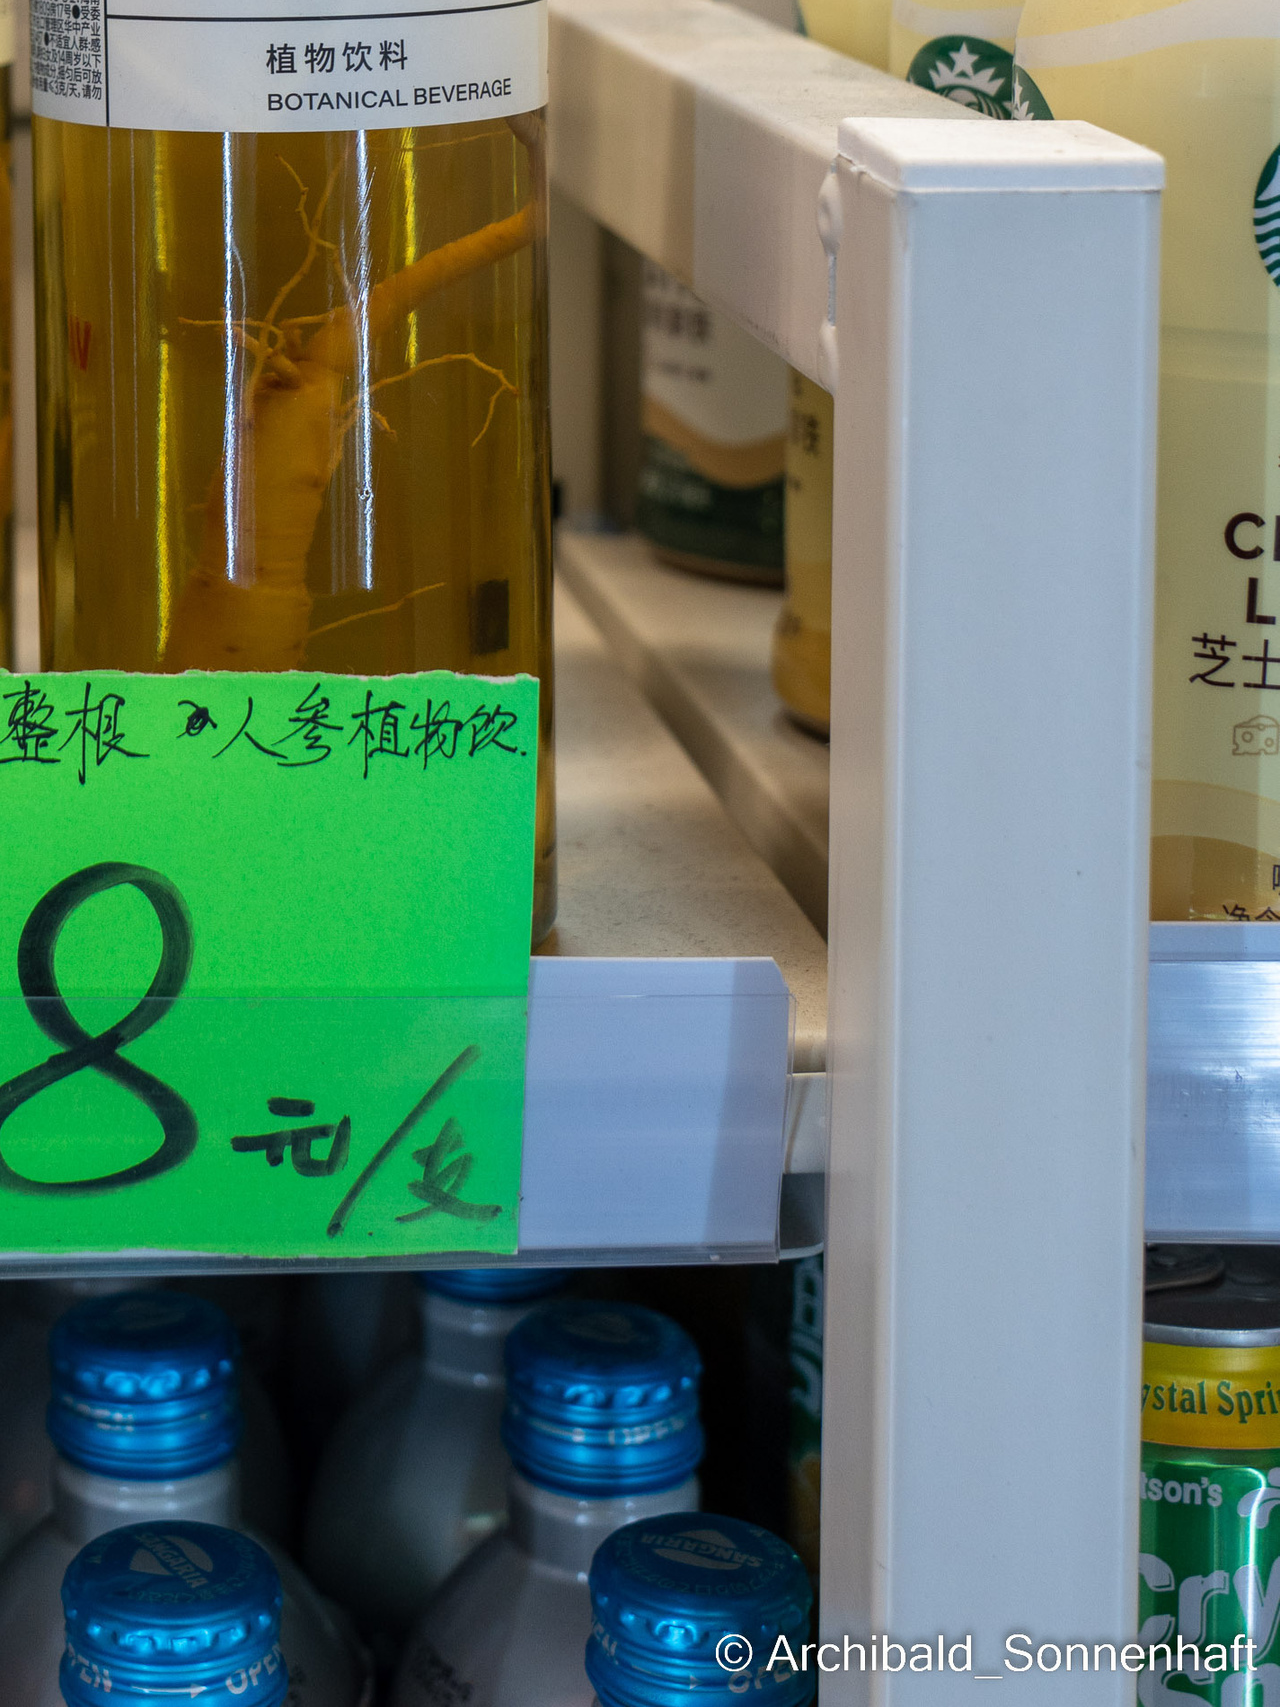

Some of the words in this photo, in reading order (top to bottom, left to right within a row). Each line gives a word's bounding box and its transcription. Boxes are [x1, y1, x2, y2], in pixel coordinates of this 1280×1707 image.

[266, 39, 410, 76] 植物饮料
[266, 90, 409, 113] BOTANICAL
[412, 77, 513, 106] BEVERAGE
